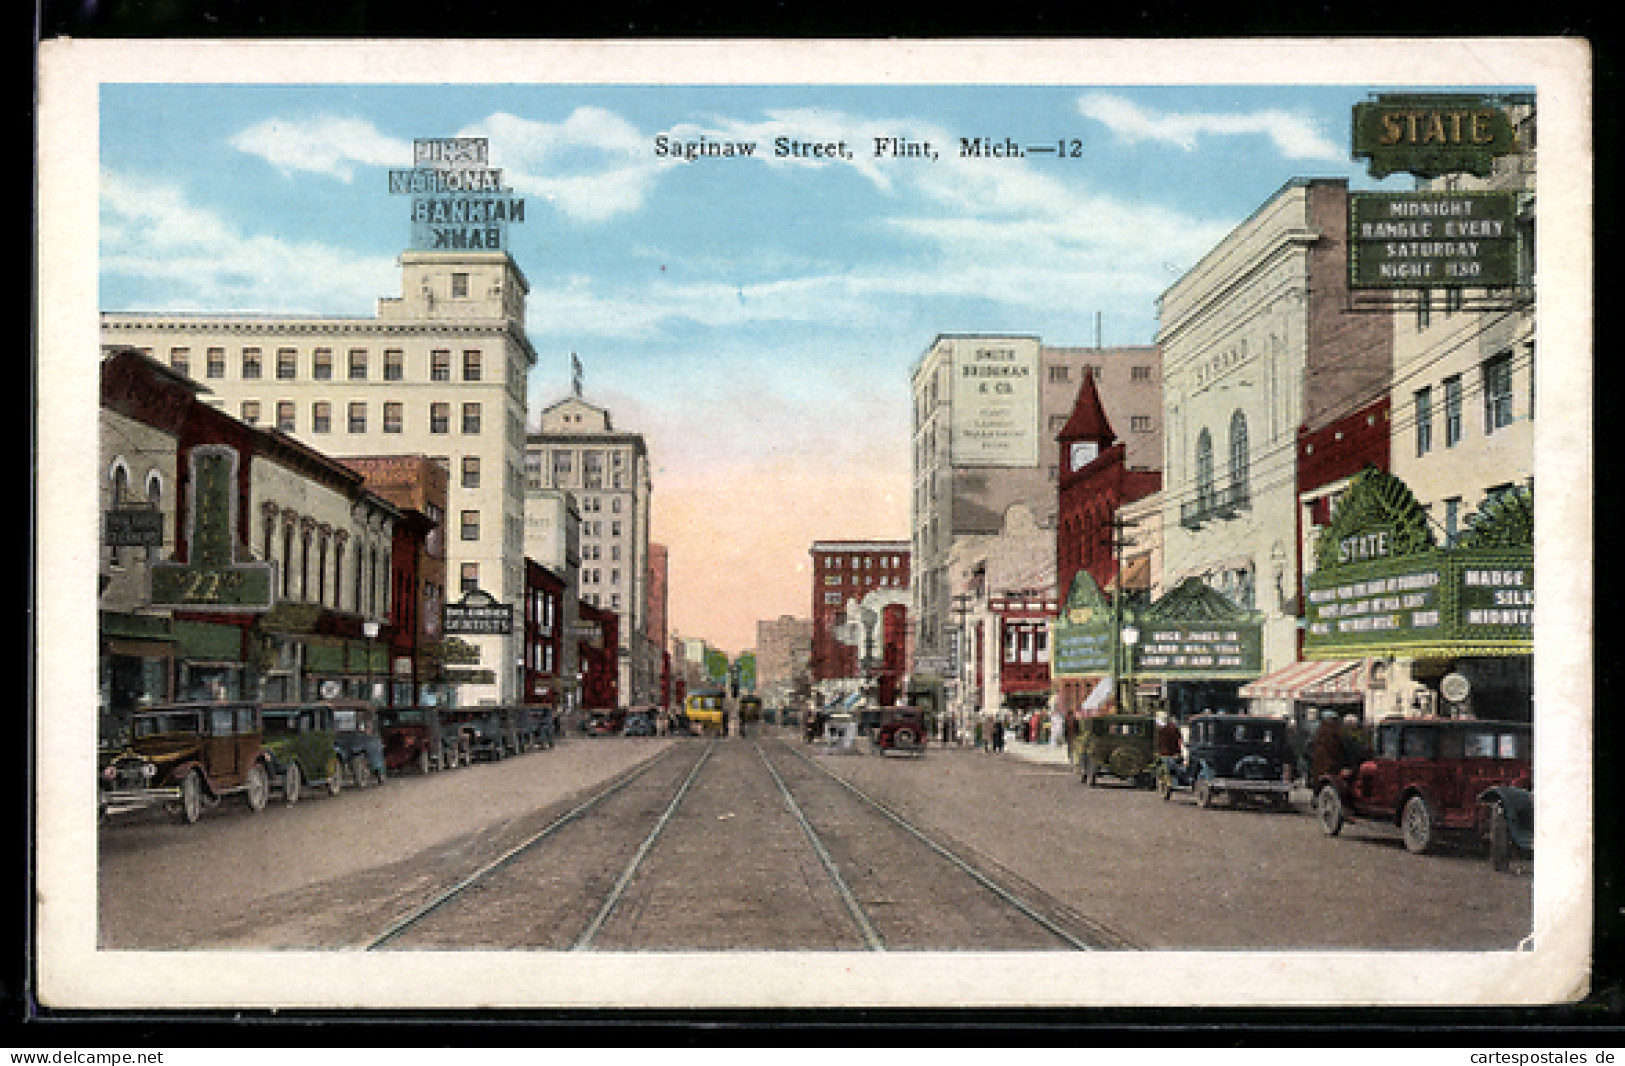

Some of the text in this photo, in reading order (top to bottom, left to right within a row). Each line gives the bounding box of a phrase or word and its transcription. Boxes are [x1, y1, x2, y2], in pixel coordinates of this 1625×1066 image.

[1379, 109, 1494, 145] STATE
[1390, 201, 1472, 216] MIDNIGHT
[1387, 242, 1479, 257] SATURDAY
[1379, 262, 1432, 277] NIGHT
[1338, 532, 1388, 563] STATE
